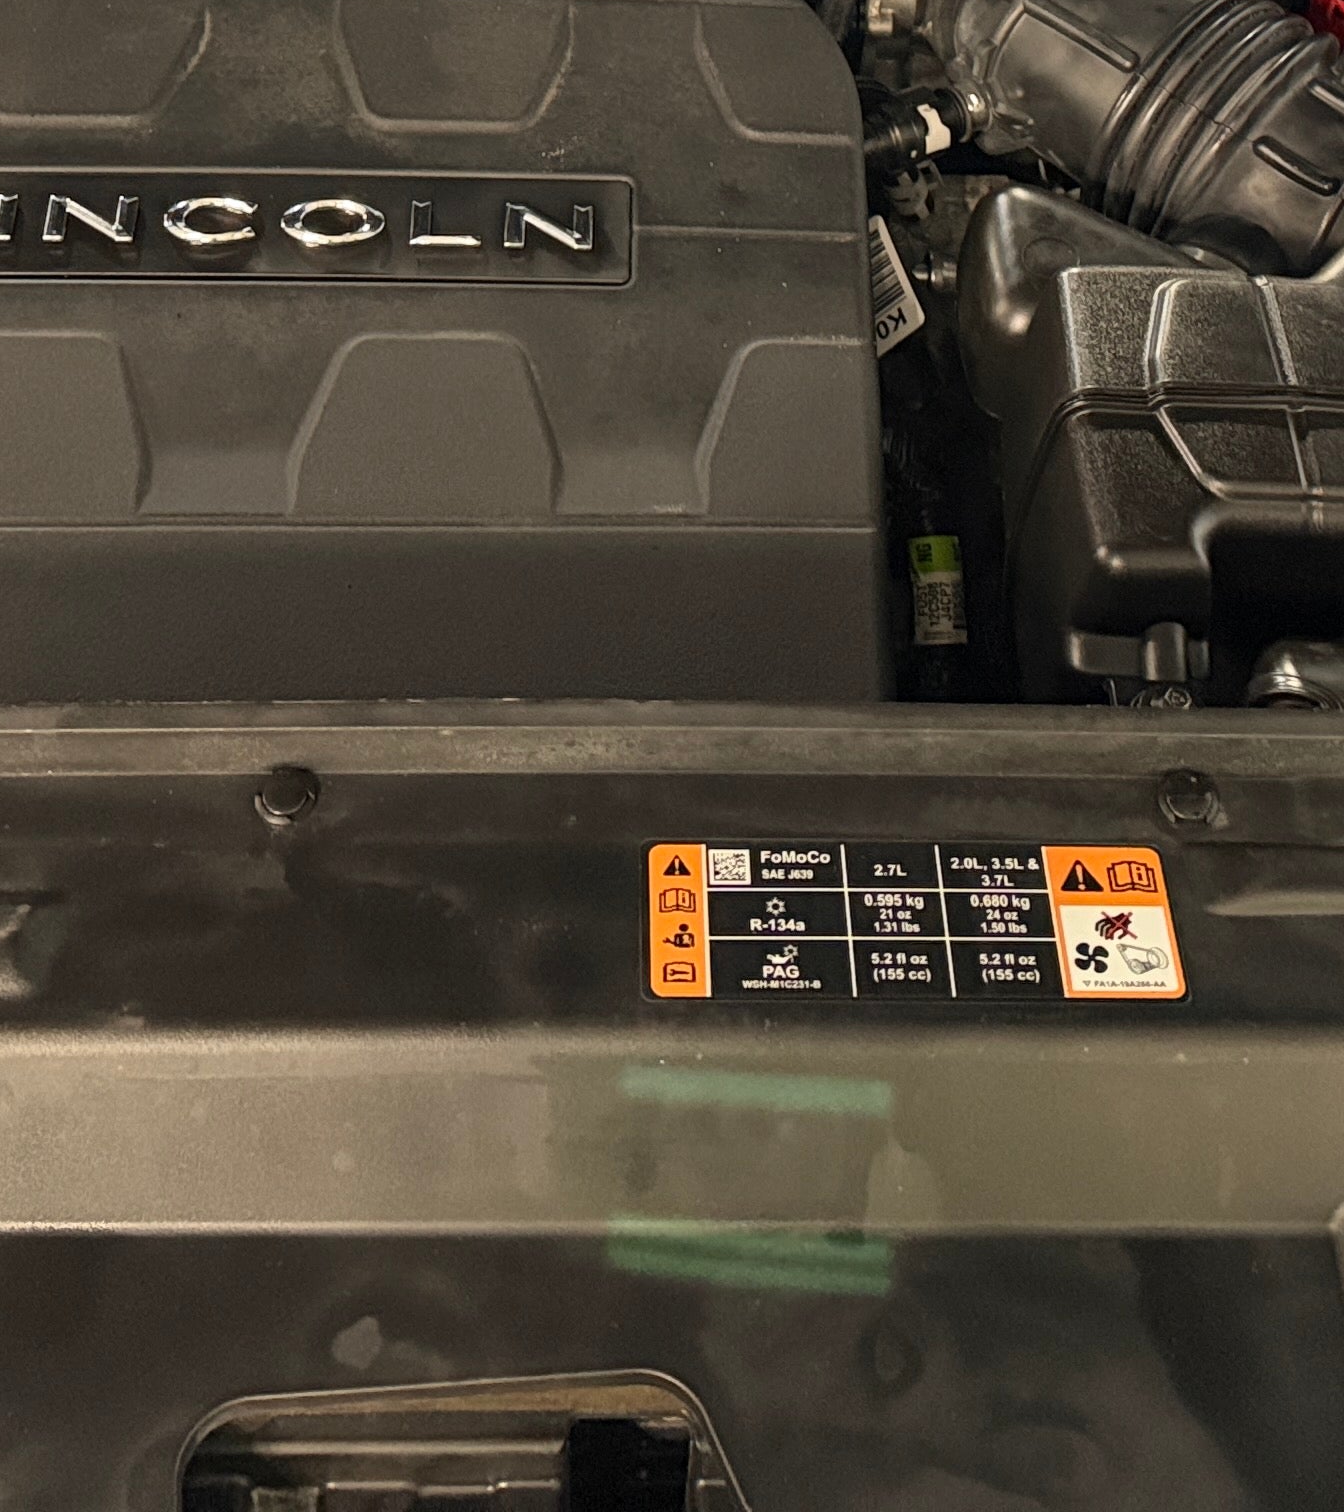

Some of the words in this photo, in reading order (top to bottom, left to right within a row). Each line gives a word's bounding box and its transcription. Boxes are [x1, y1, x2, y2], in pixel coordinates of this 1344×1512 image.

[760, 850, 831, 864] FoMoCo
[873, 864, 908, 877] 2.7L
[950, 857, 988, 871] 2.0L,
[991, 857, 1024, 870] 3.5L
[1027, 858, 1040, 870] &
[761, 869, 786, 880] SAE
[788, 869, 814, 880] J639
[981, 874, 1015, 887] 3.7L
[863, 893, 903, 907] 0.595
[905, 893, 925, 910] kg
[969, 894, 1009, 908] 0.680
[1011, 894, 1031, 910] kg
[879, 908, 894, 920] 21
[896, 910, 912, 920] oz
[985, 909, 1001, 920] 24
[1003, 911, 1019, 921] oz
[749, 918, 806, 932] R-134a
[873, 921, 897, 933] 1.31
[901, 921, 921, 933] lbs
[980, 922, 1006, 933] 1.50
[1008, 922, 1028, 934] lbs
[870, 952, 893, 965] 5.2
[895, 952, 907, 965] fl
[909, 955, 929, 965] oz
[979, 953, 1001, 965] 5.2
[1004, 953, 1015, 966] fl
[1018, 955, 1037, 966] oz
[762, 965, 800, 979] PAG
[873, 968, 905, 983] (155
[908, 968, 932, 983] cc)
[981, 968, 1014, 984] (155
[1017, 969, 1041, 984] cc)
